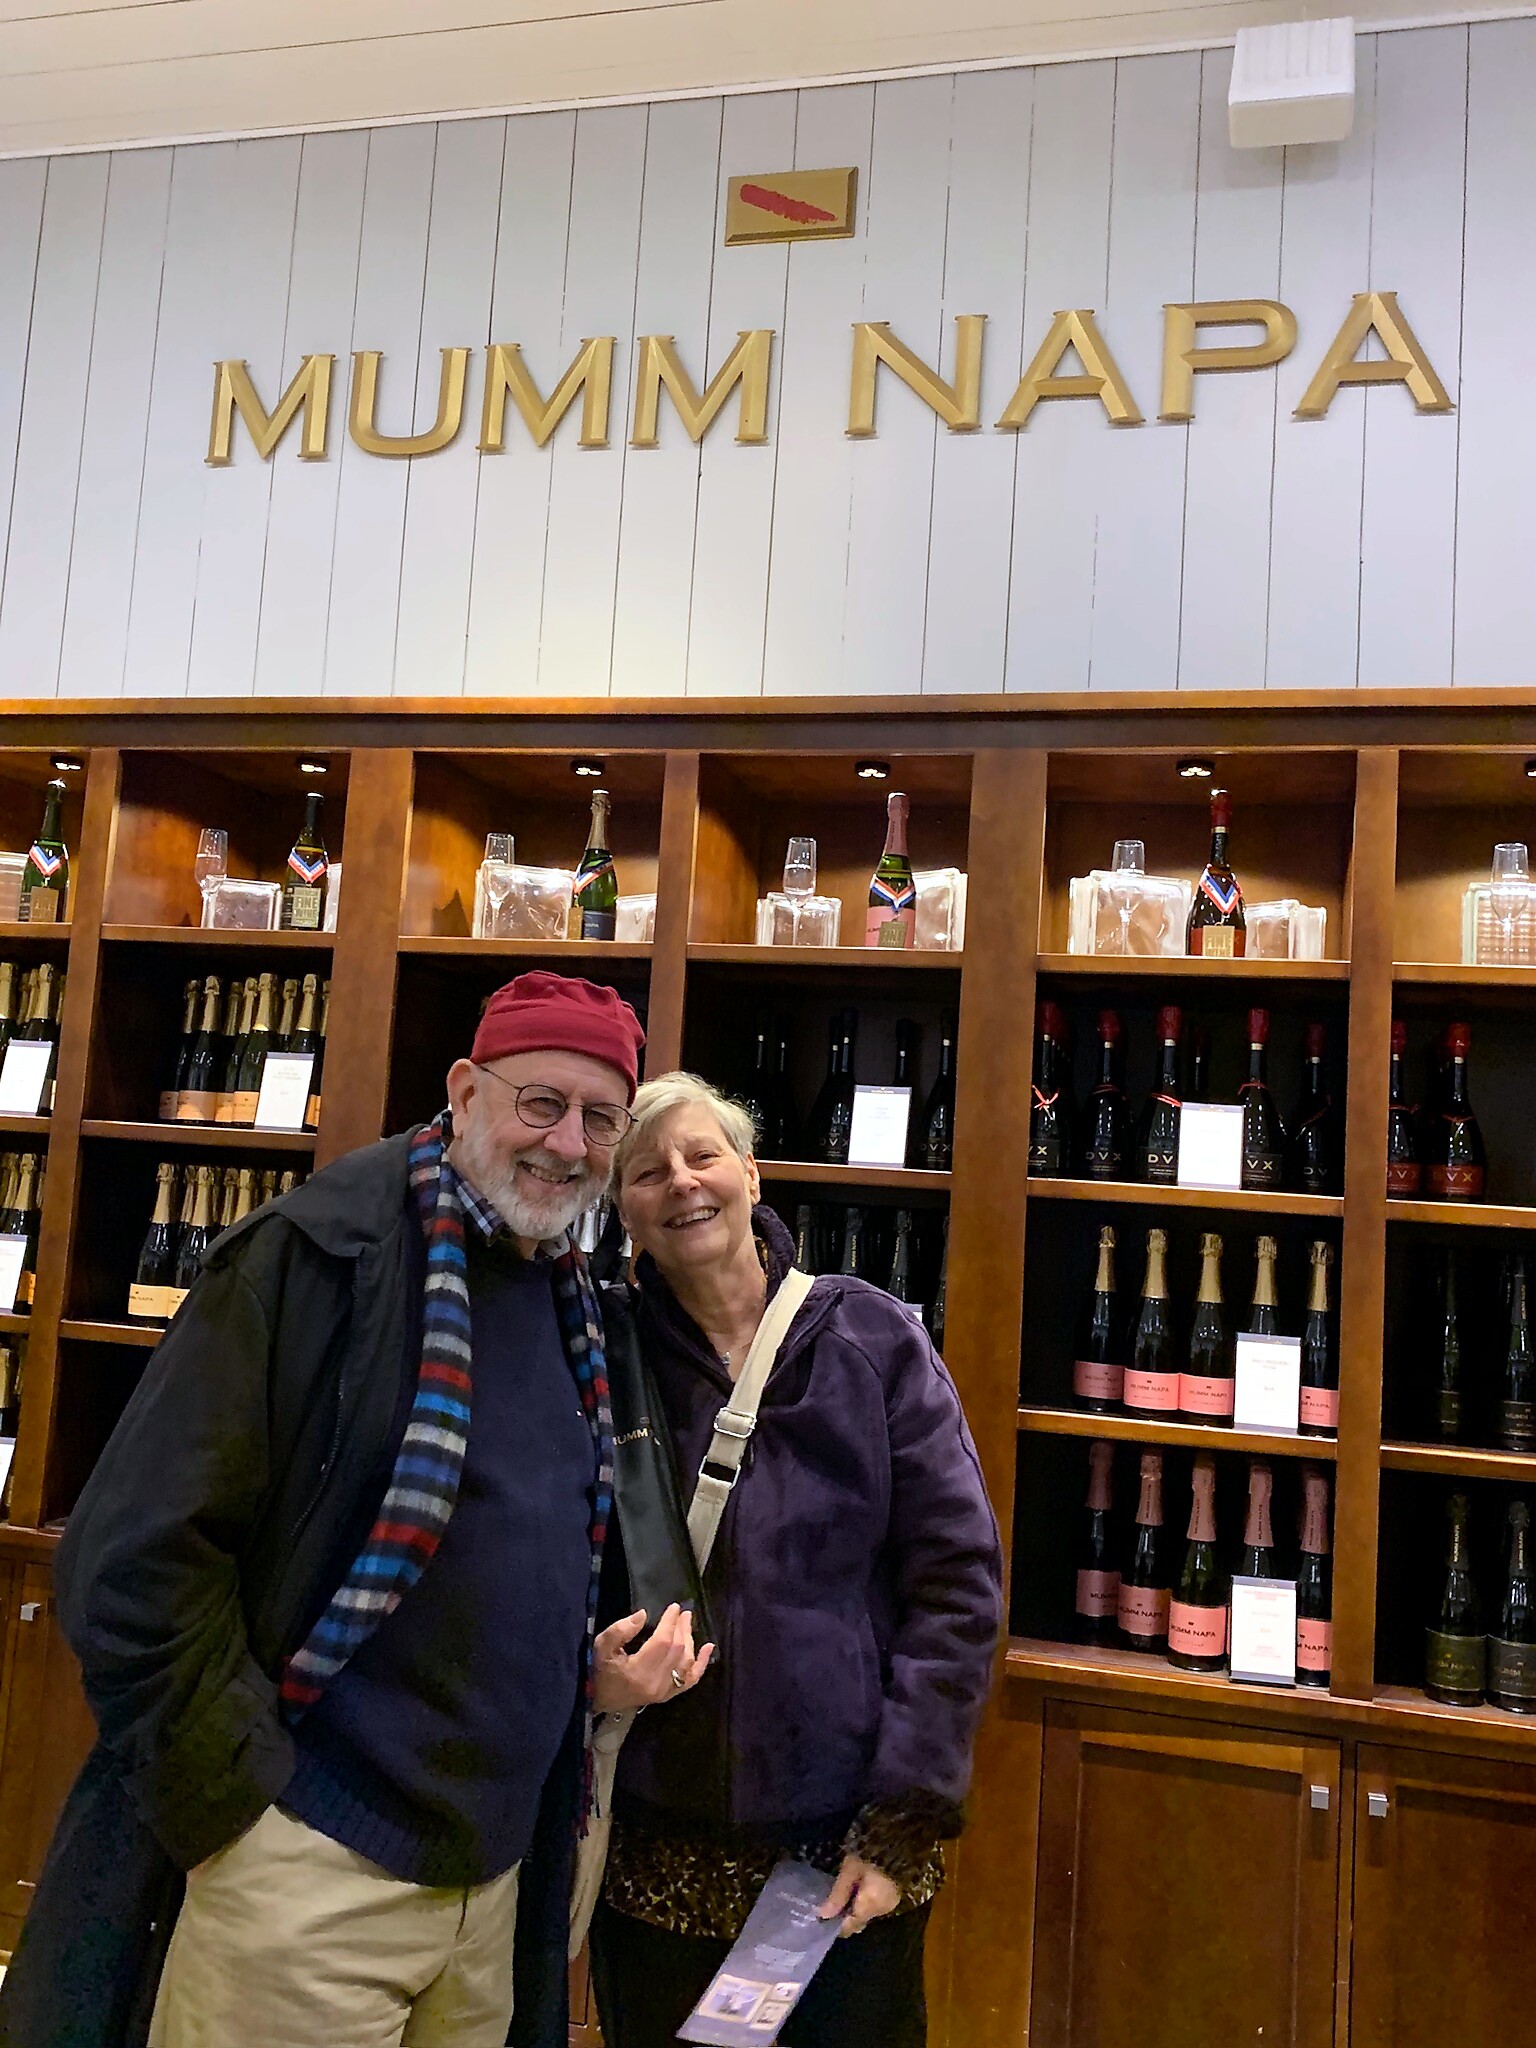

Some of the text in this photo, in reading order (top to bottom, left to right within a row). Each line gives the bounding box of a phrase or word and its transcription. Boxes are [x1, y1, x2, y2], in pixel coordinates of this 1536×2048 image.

[204, 291, 1457, 466] MUMM NAPA
[1085, 1151, 1121, 1161] DVX
[1147, 1153, 1174, 1165] DV
[1246, 1159, 1274, 1171] VX
[1303, 1166, 1328, 1176] DV
[1446, 1172, 1473, 1183] VX
[1193, 1630, 1217, 1639] NAPA
[1304, 1643, 1329, 1652] NAPA
